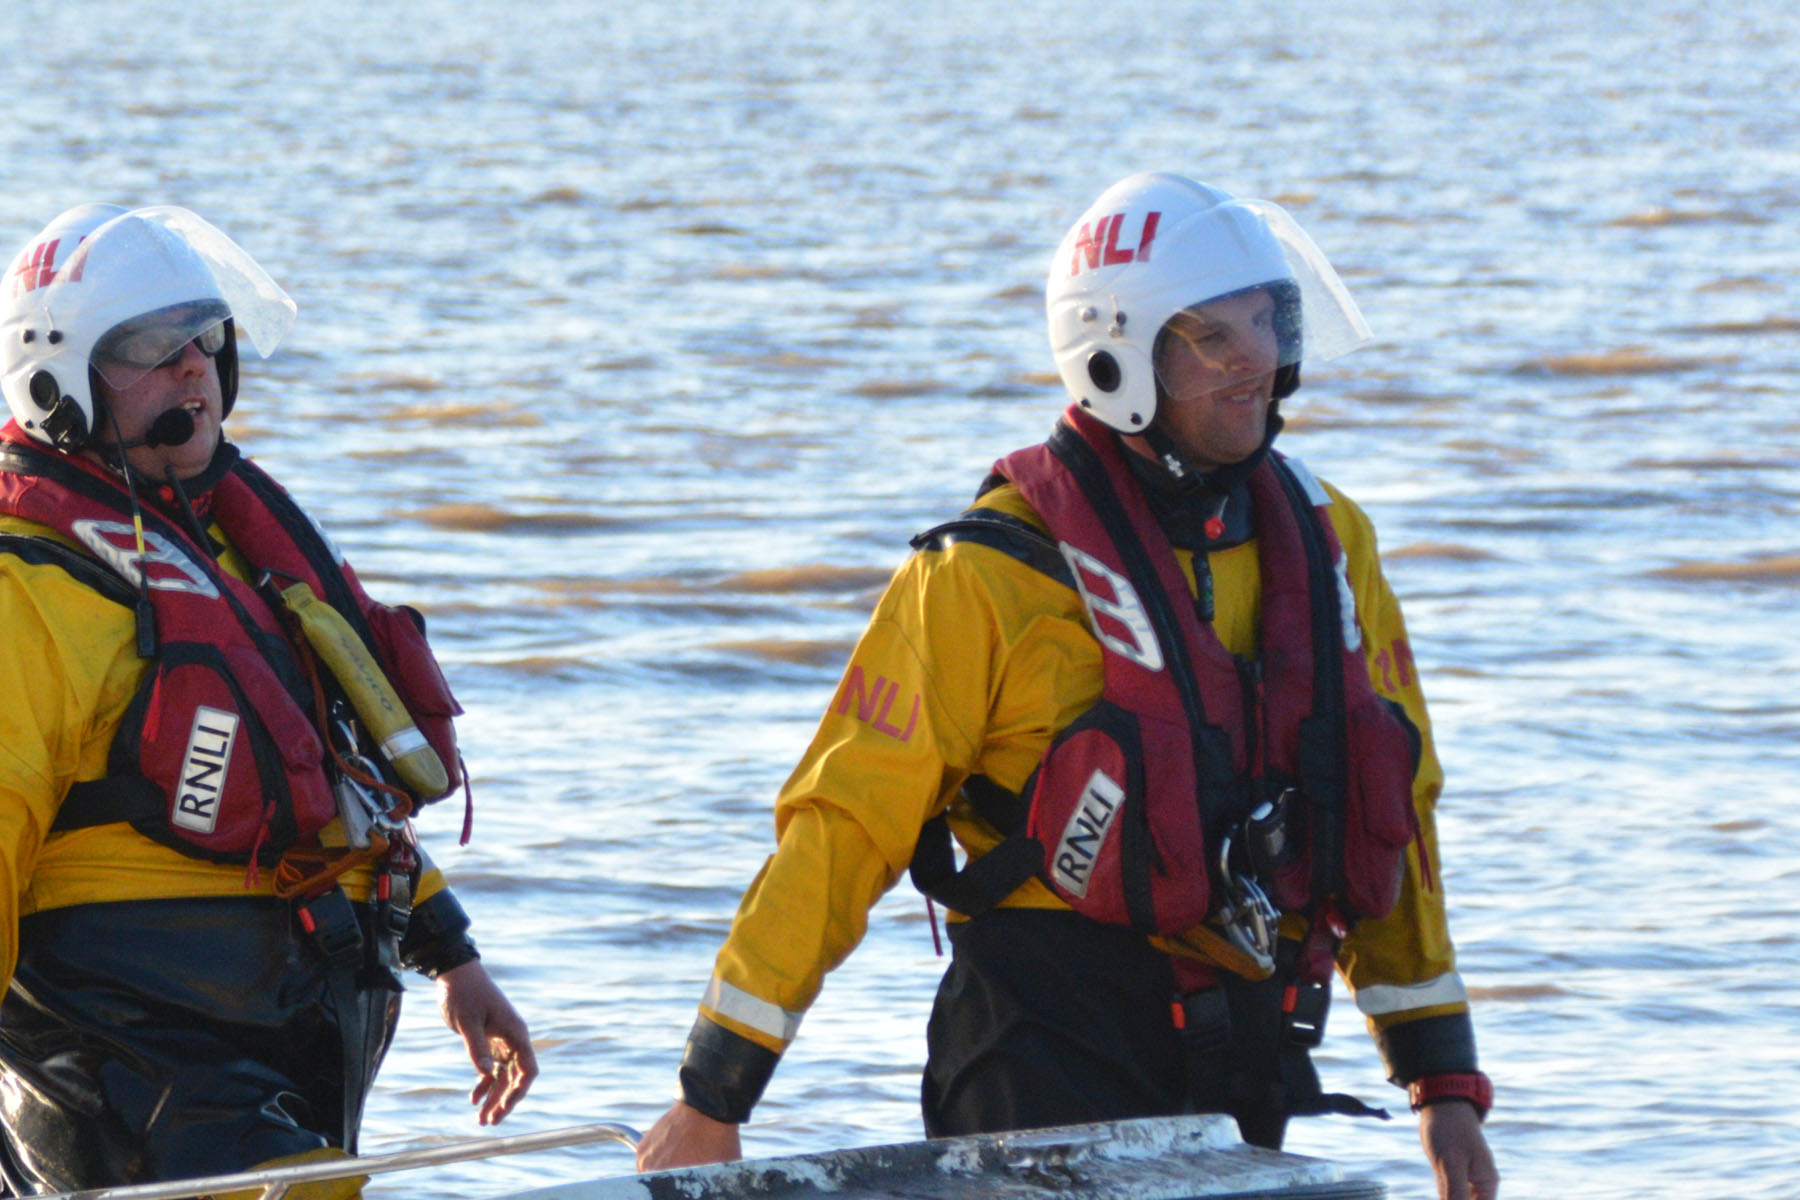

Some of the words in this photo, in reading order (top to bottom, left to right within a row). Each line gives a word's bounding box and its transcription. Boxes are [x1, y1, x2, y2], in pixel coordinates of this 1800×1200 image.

[12, 235, 89, 299] NLI
[1070, 210, 1162, 277] NLI
[834, 664, 921, 743] NLI
[179, 724, 231, 819] RNLI
[1057, 787, 1114, 885] RNLI
